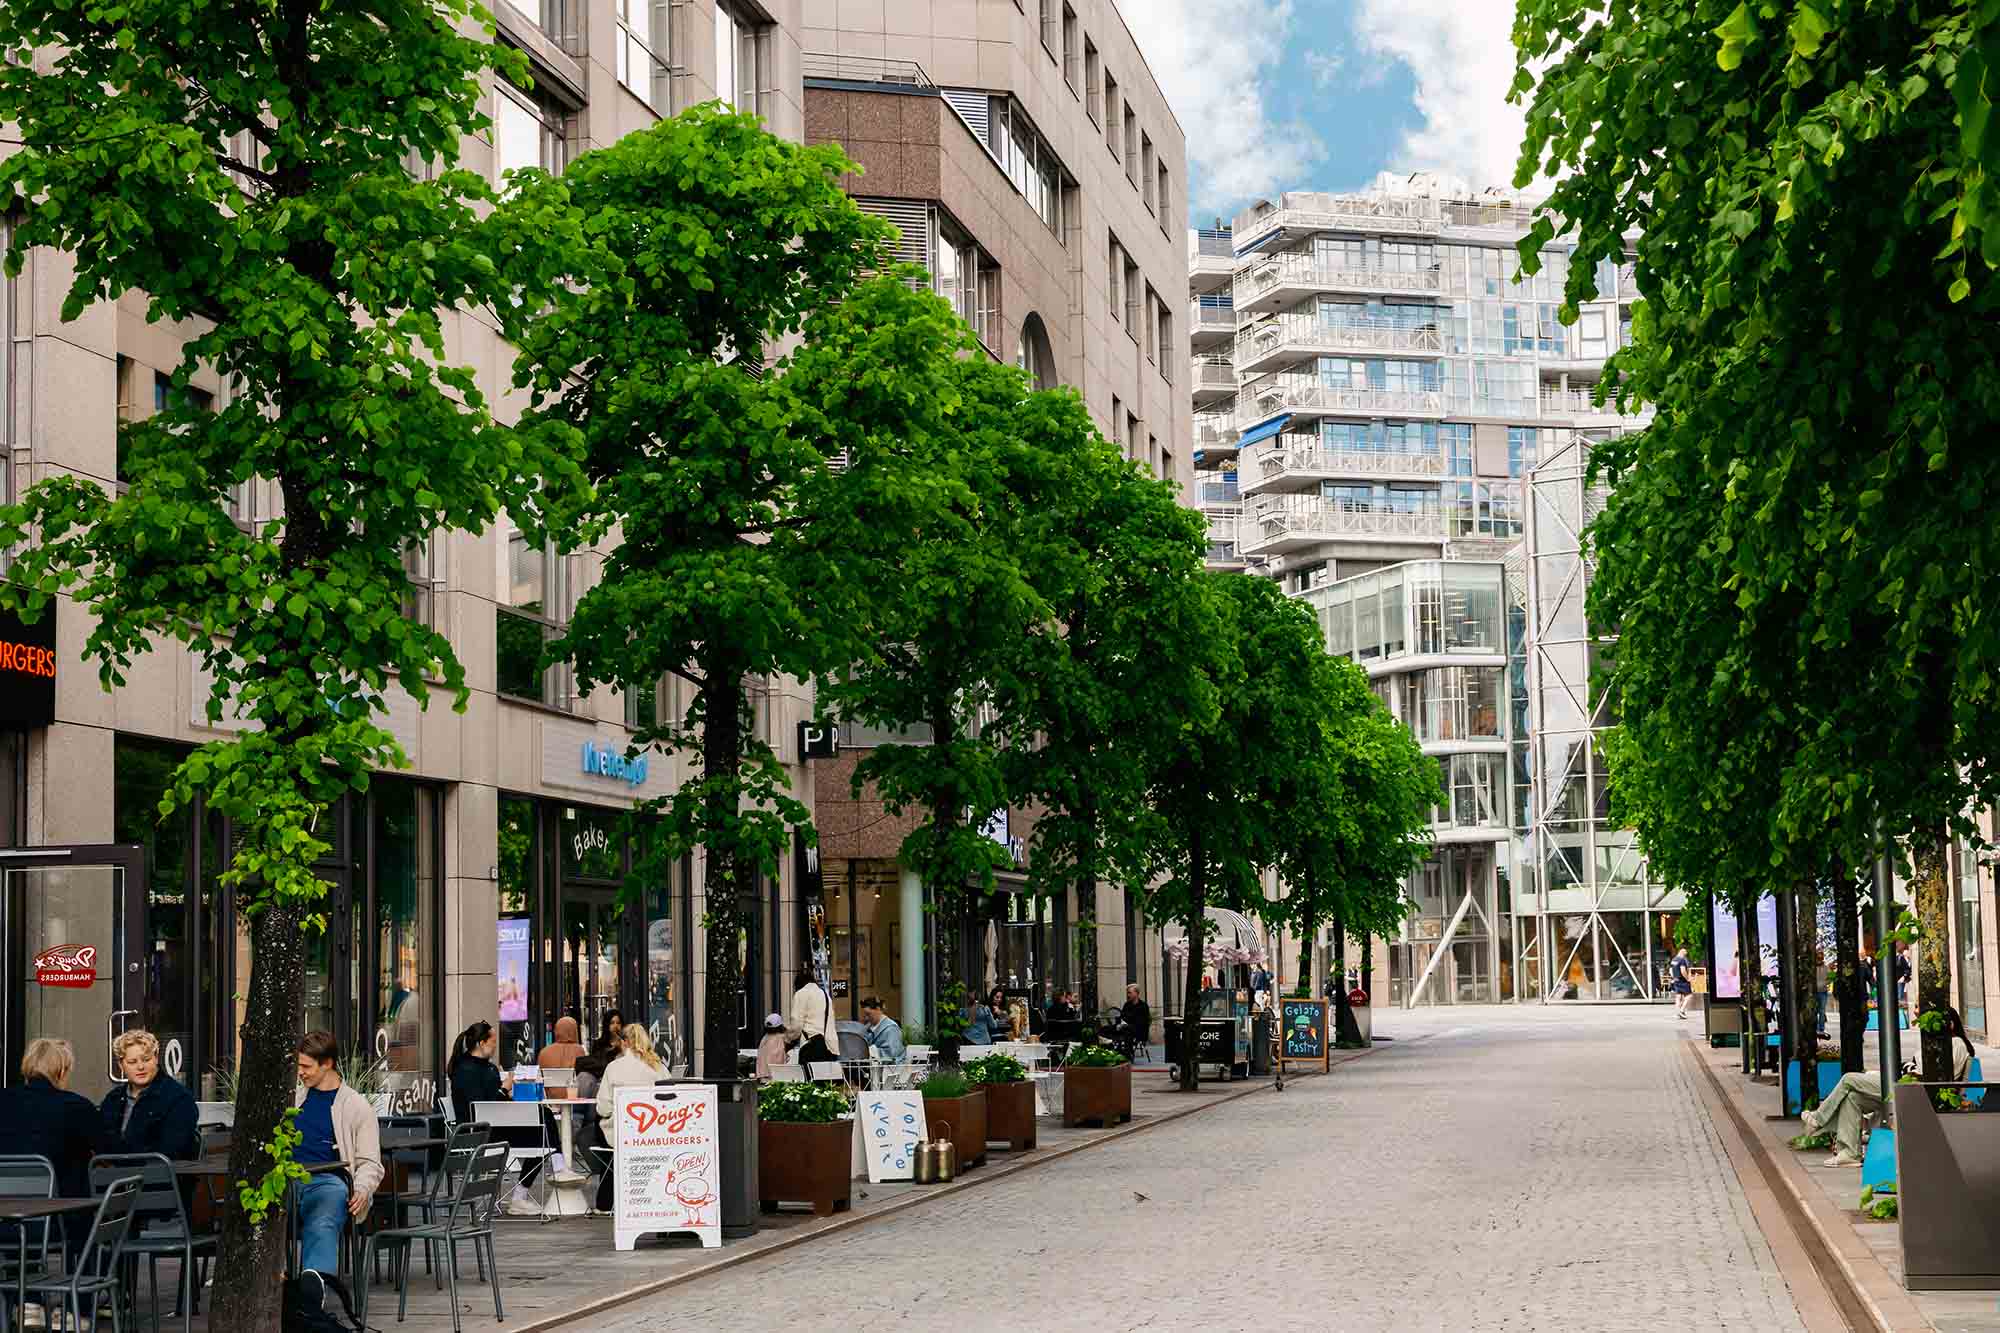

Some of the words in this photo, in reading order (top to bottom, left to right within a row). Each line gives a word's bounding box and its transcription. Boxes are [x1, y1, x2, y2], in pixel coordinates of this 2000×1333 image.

[804, 727, 824, 753] P
[574, 821, 609, 862] Baker
[1284, 1003, 1320, 1017] Gelato
[1288, 1040, 1318, 1056] Pastry
[626, 1102, 705, 1136] Doug's
[632, 1135, 703, 1147] HAMBURGERS
